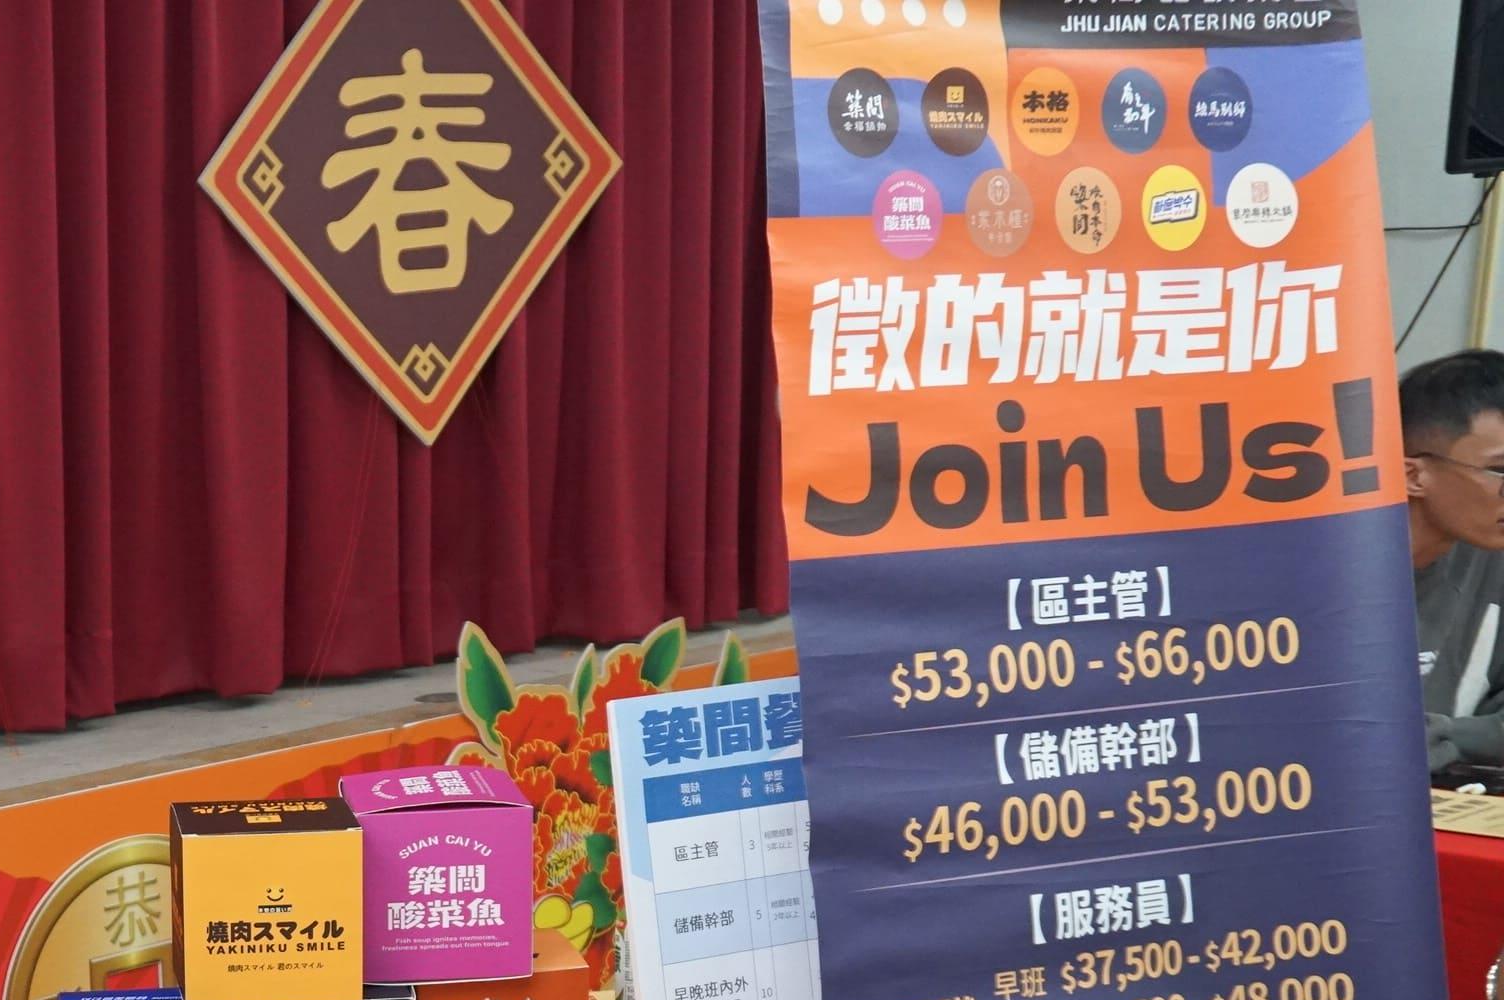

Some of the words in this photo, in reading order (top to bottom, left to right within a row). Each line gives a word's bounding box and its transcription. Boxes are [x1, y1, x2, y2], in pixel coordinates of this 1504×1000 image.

[1061, 15, 1097, 32] JHU
[1103, 14, 1146, 32] JIAN
[1153, 12, 1256, 32] CATERING
[1263, 10, 1332, 29] GROUP
[842, 89, 884, 119] 築間
[1022, 90, 1069, 113] 本格
[321, 48, 515, 294] 春
[892, 196, 924, 212] 築間
[883, 215, 931, 232] 酸菜魚
[808, 260, 1343, 397] 徵的就是你
[804, 399, 1109, 537] Join
[1135, 376, 1381, 512] Us!
[1007, 566, 1172, 631] 【區主管】
[890, 637, 1075, 709] $53,000
[1115, 616, 1300, 686] $66,000
[902, 788, 1087, 863] $46,000
[1126, 762, 1313, 836] $53,000
[398, 835, 440, 859] SUAN
[445, 834, 470, 847] CAI
[473, 841, 493, 858] YU
[674, 841, 718, 862] 區主管
[749, 840, 756, 849] 3
[407, 864, 486, 895] 築間
[104, 870, 161, 947] 恭
[387, 897, 505, 931] 酸菜魚
[756, 909, 762, 920] 5
[1029, 873, 1198, 945] 【服務員】
[206, 920, 344, 944] 燒肉スマイル
[674, 910, 735, 934] 儲備幹部
[206, 944, 287, 955] YAKINIKU
[296, 941, 345, 952] SMILE
[761, 988, 773, 998] 10
